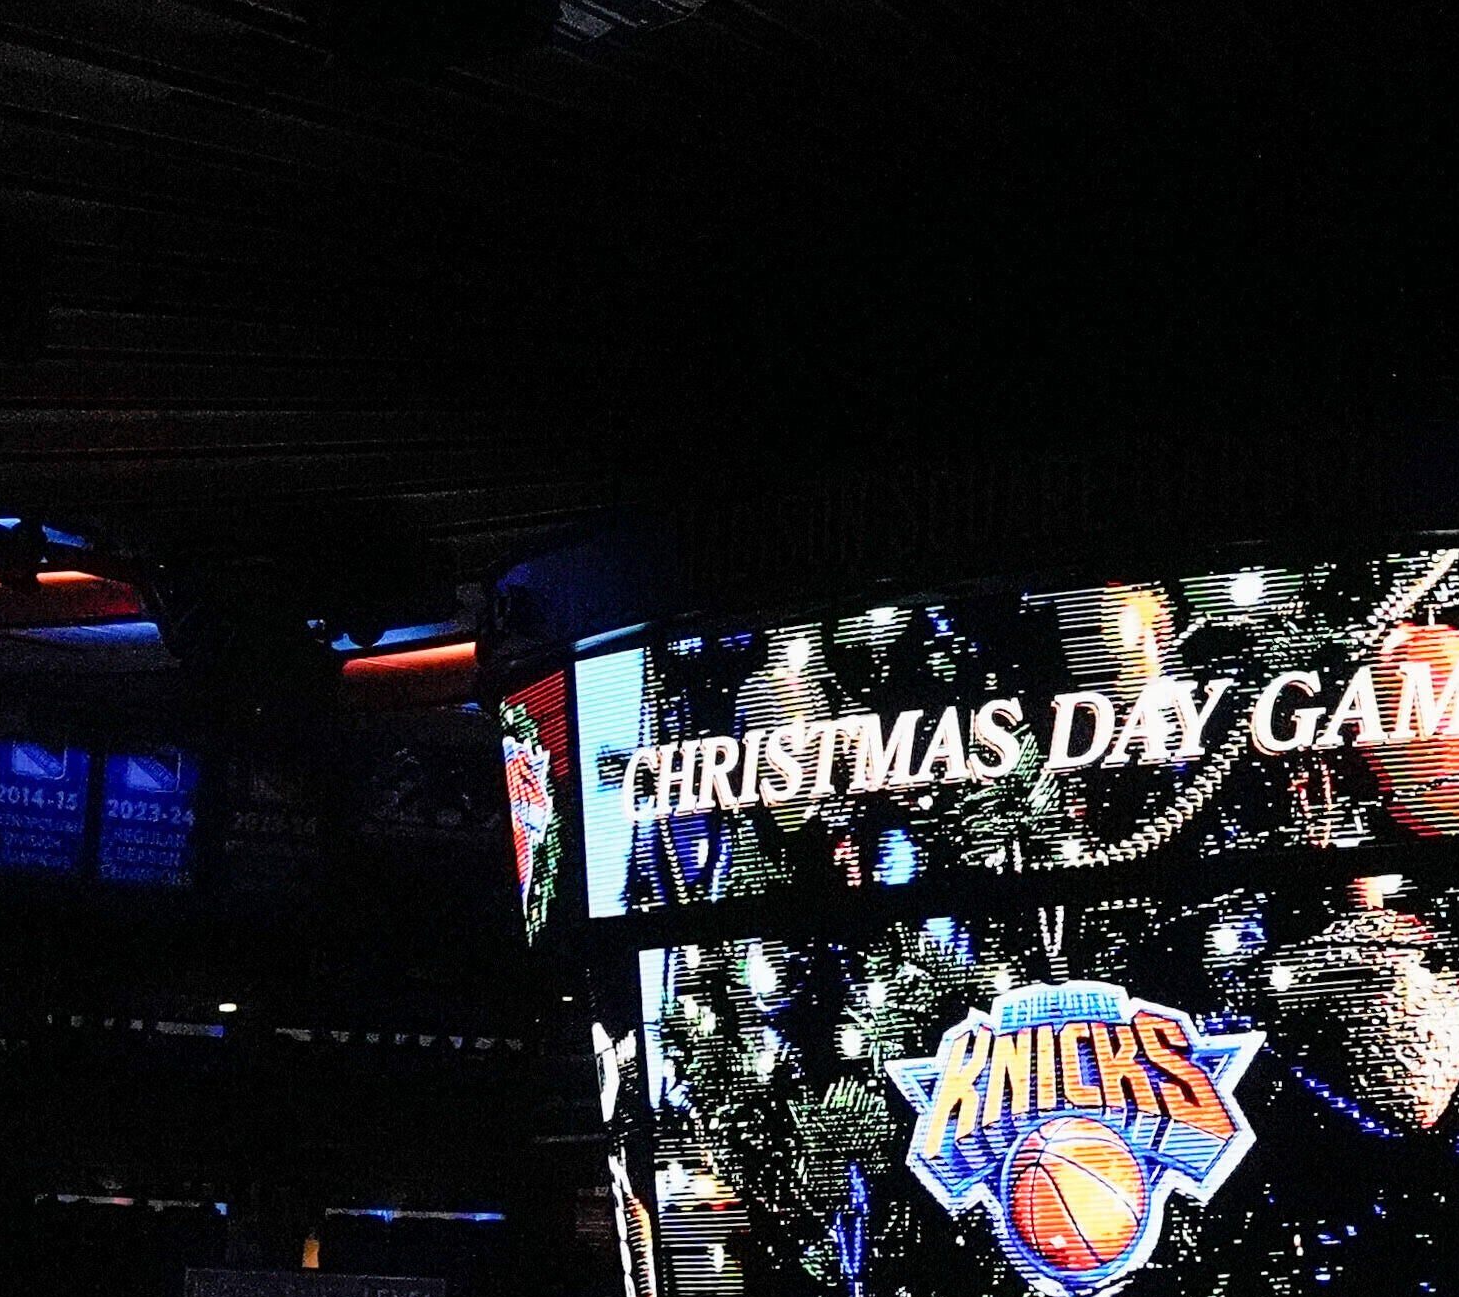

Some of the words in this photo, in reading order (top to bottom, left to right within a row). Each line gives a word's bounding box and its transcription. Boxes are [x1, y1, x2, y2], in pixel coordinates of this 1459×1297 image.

[622, 698, 1023, 824] CHRISTMAS
[1042, 676, 1236, 771] DAY
[922, 1009, 1238, 1160] KNICKS
